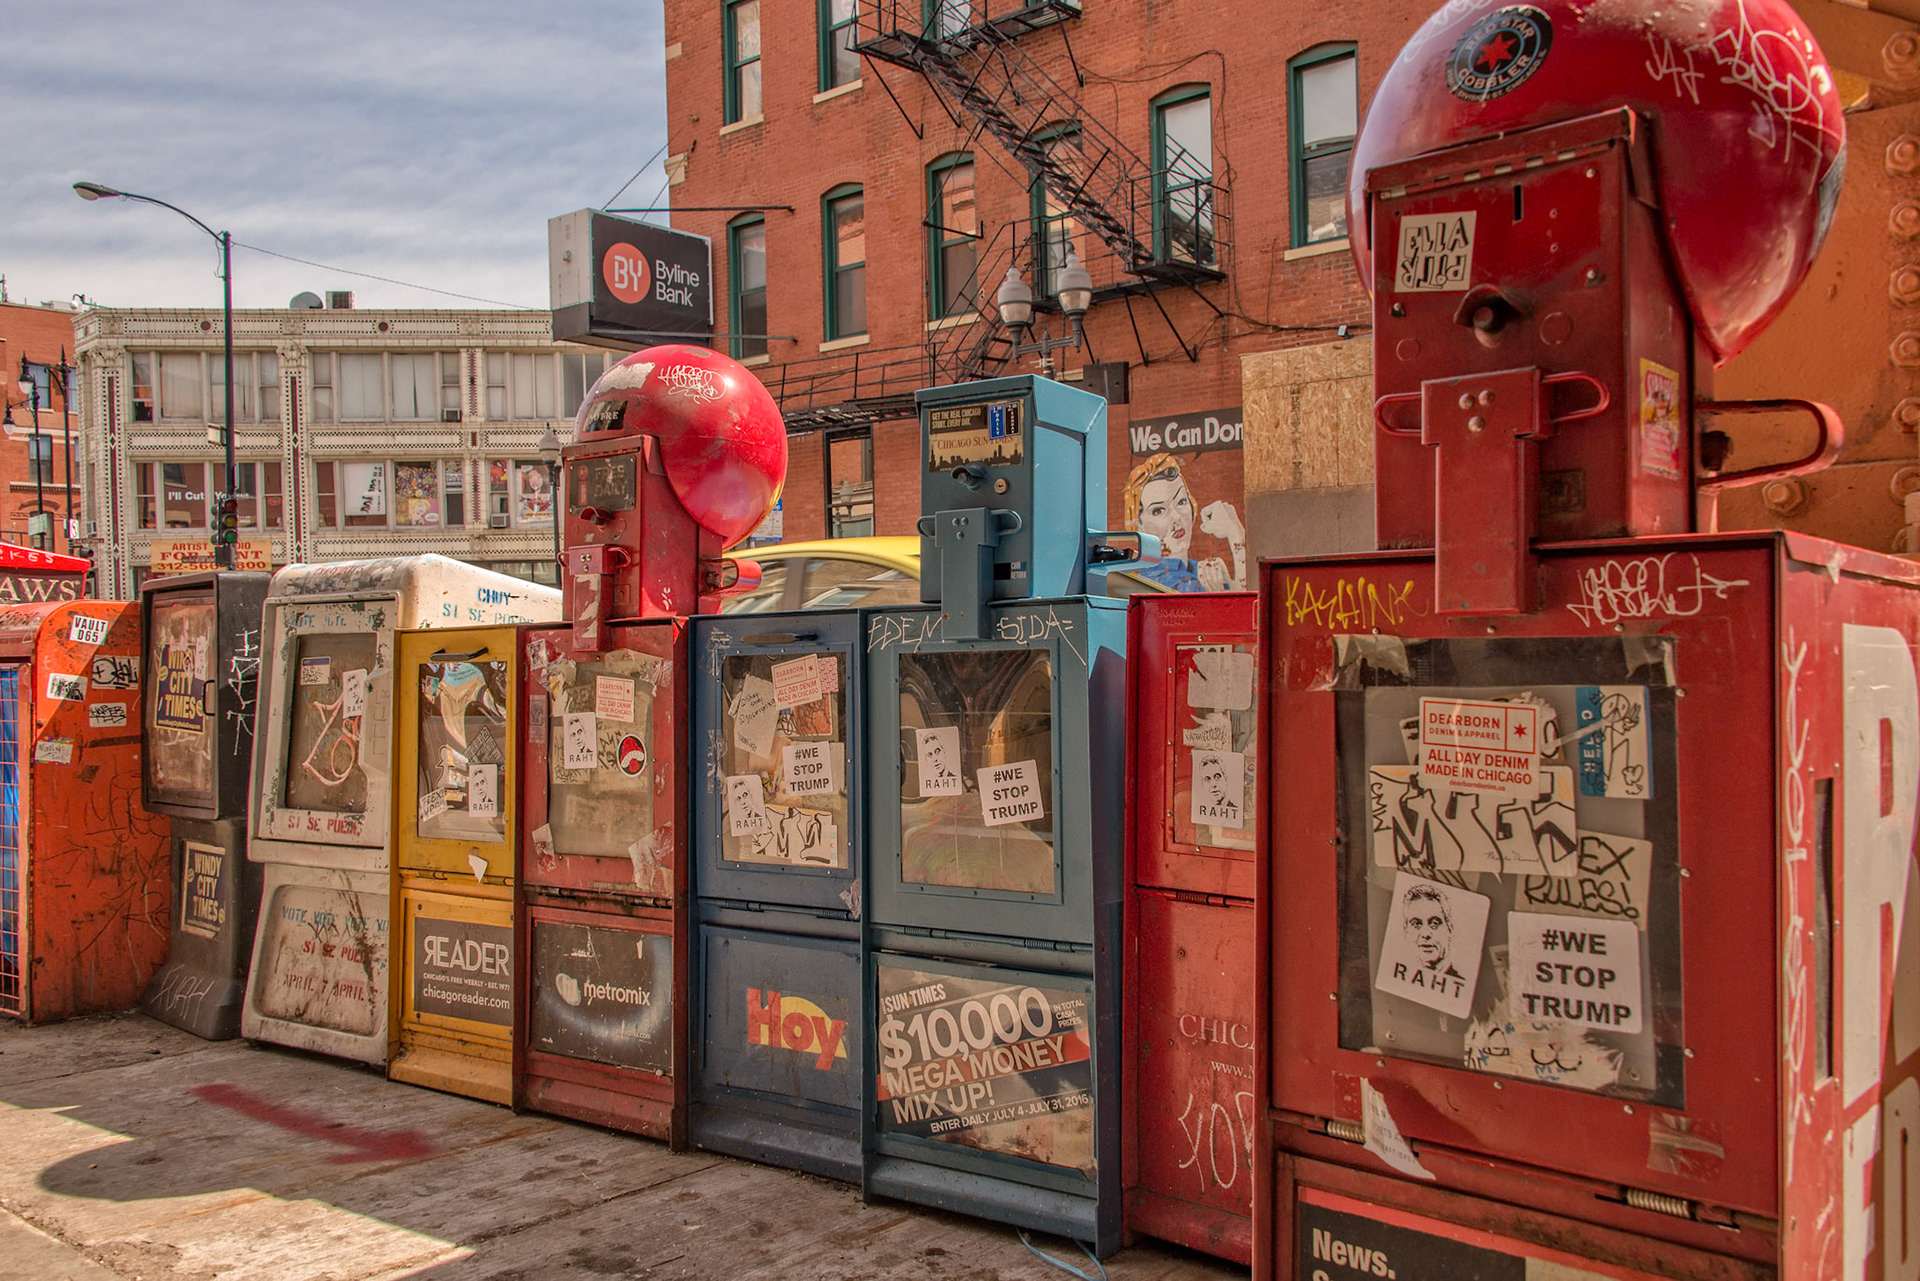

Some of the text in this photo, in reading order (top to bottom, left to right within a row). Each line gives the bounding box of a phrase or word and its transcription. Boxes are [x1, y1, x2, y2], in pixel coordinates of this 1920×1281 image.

[1500, 18, 1535, 40] STAR
[614, 255, 642, 292] BY
[655, 259, 700, 287] Byline
[655, 281, 693, 307] Bank
[938, 438, 972, 449] CHICAGO
[1130, 426, 1162, 452] We
[1164, 422, 1201, 449] Can
[168, 491, 182, 500] I'll
[185, 491, 205, 500] Cut
[172, 542, 208, 551] ARTIST
[477, 587, 511, 606] CHUY
[73, 617, 107, 632] VAULT
[77, 630, 99, 643] D65
[169, 671, 193, 695] CITY
[165, 694, 196, 720] TIMES
[1429, 712, 1500, 729] DEARBORN
[1429, 727, 1455, 736] DENIM
[1465, 730, 1501, 741] APPAREL
[1582, 709, 1596, 774] HELO
[569, 754, 594, 763] RAHT
[795, 748, 819, 759] #WE
[1428, 749, 1529, 770] ALL DAY DENIM
[793, 763, 823, 776] STOP
[993, 767, 1023, 783] #WE
[1425, 763, 1532, 785] MADE IN CHICAGO
[790, 778, 830, 792] TRUMP
[925, 778, 957, 789] RAHT
[993, 784, 1029, 801] STOP
[1449, 780, 1506, 792] dearborndenim.us
[472, 803, 495, 811] RAHT
[989, 801, 1039, 820] TRUMP
[1199, 805, 1238, 820] RAHT
[307, 818, 321, 832] SE
[736, 817, 764, 829] RAHT
[194, 853, 222, 877] WINDY
[197, 875, 217, 898] CITY
[193, 896, 219, 922] TIMES
[282, 905, 308, 924] VOTE
[1542, 928, 1606, 955] #WE
[423, 935, 510, 977] READER
[423, 972, 450, 982] CHICAGO'S
[451, 976, 463, 984] FREE
[464, 977, 484, 988] WEEKLY
[499, 983, 510, 991] 1971
[1393, 962, 1465, 998] RAHT
[1535, 961, 1616, 989] STOP
[423, 983, 511, 1010] chicagoreader.com
[583, 977, 651, 1006] metromix
[1053, 999, 1085, 1012] IN TOTAL
[1056, 1009, 1075, 1020] CASH
[1522, 993, 1632, 1025] TRUMP
[747, 988, 847, 1071] Hoy
[880, 987, 1053, 1071] $10,000
[1058, 1016, 1082, 1028] PRIZES
[1179, 1013, 1253, 1050] CHIC
[887, 1036, 1065, 1097] MEGA MONEY
[893, 1080, 996, 1124] MIX UP!
[931, 1119, 961, 1134] ENTER
[962, 1113, 990, 1128] DAILY
[992, 1106, 1015, 1121] JULY
[1052, 1100, 1064, 1112] 31,
[1066, 1093, 1089, 1108] 2016
[1312, 1228, 1396, 1280] News.
